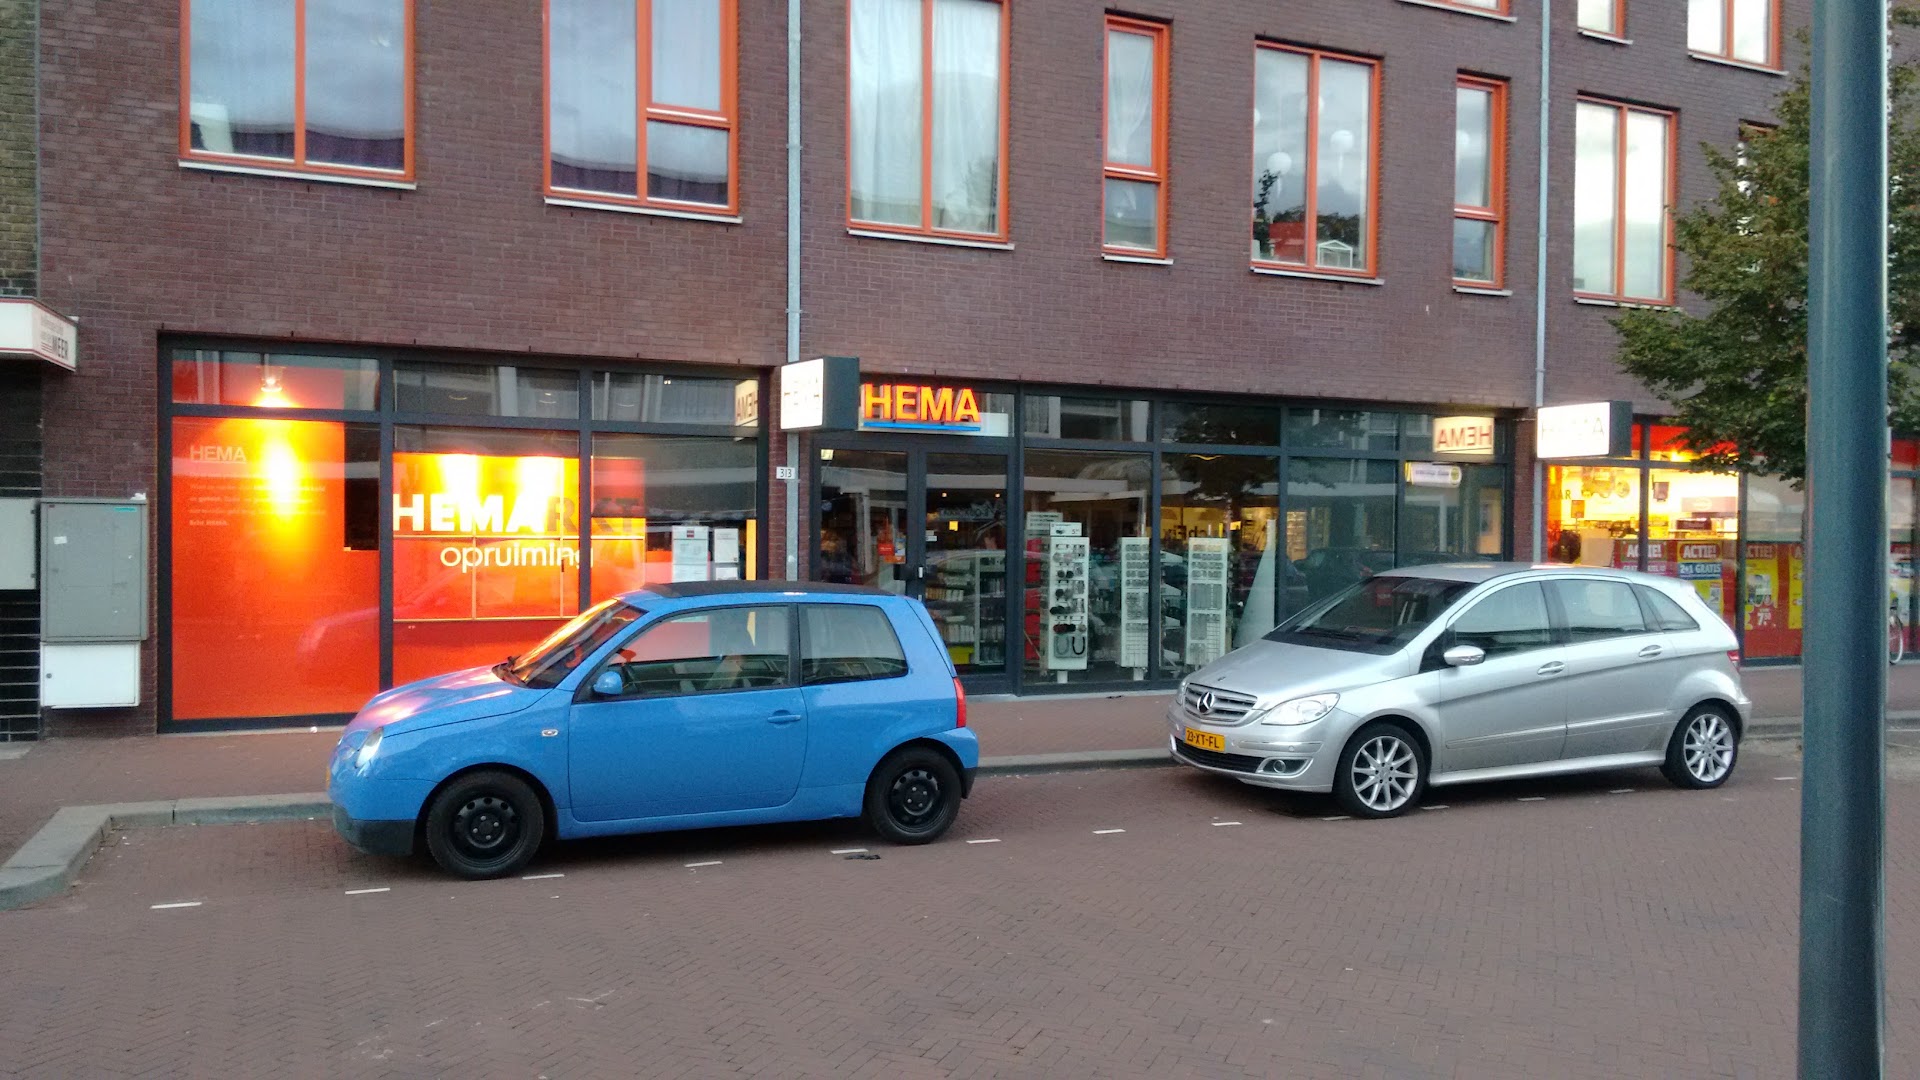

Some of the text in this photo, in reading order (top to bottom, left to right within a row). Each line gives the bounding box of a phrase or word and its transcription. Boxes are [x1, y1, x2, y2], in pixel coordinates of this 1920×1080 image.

[862, 383, 981, 422] HEMA
[190, 445, 247, 462] HEMA
[780, 468, 792, 478] 313
[1683, 545, 1717, 559] ACTIE!
[1187, 730, 1220, 749] 23-XT-FL
